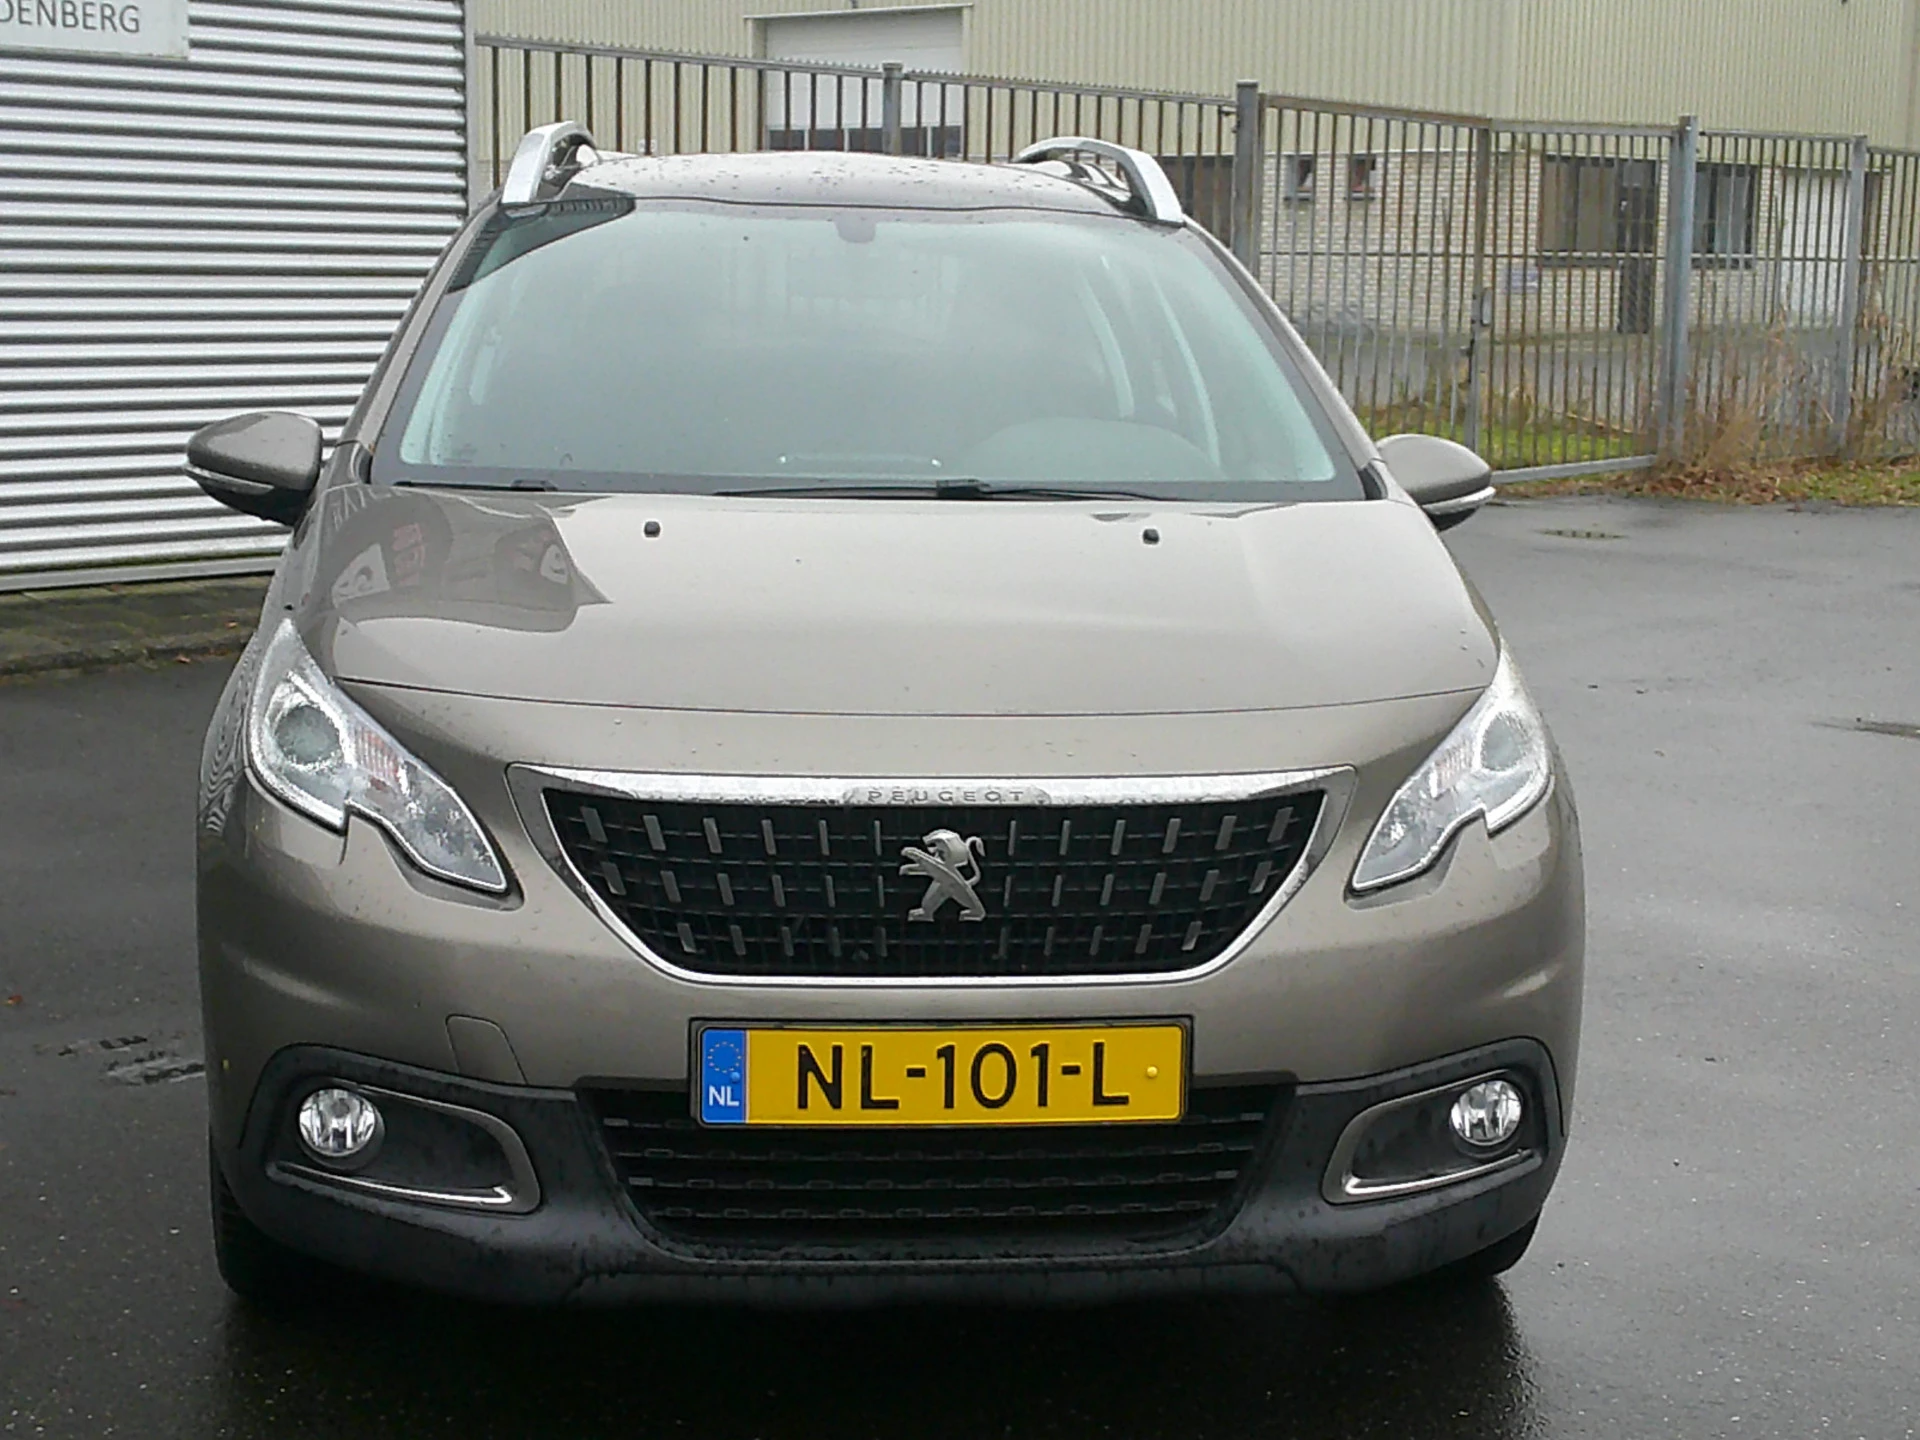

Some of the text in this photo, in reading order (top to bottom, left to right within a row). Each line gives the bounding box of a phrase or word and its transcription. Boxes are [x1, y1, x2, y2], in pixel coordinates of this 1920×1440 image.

[868, 790, 1023, 803] PEUGEOT
[796, 1041, 1130, 1110] NL-101-L
[707, 1085, 740, 1107] NL
